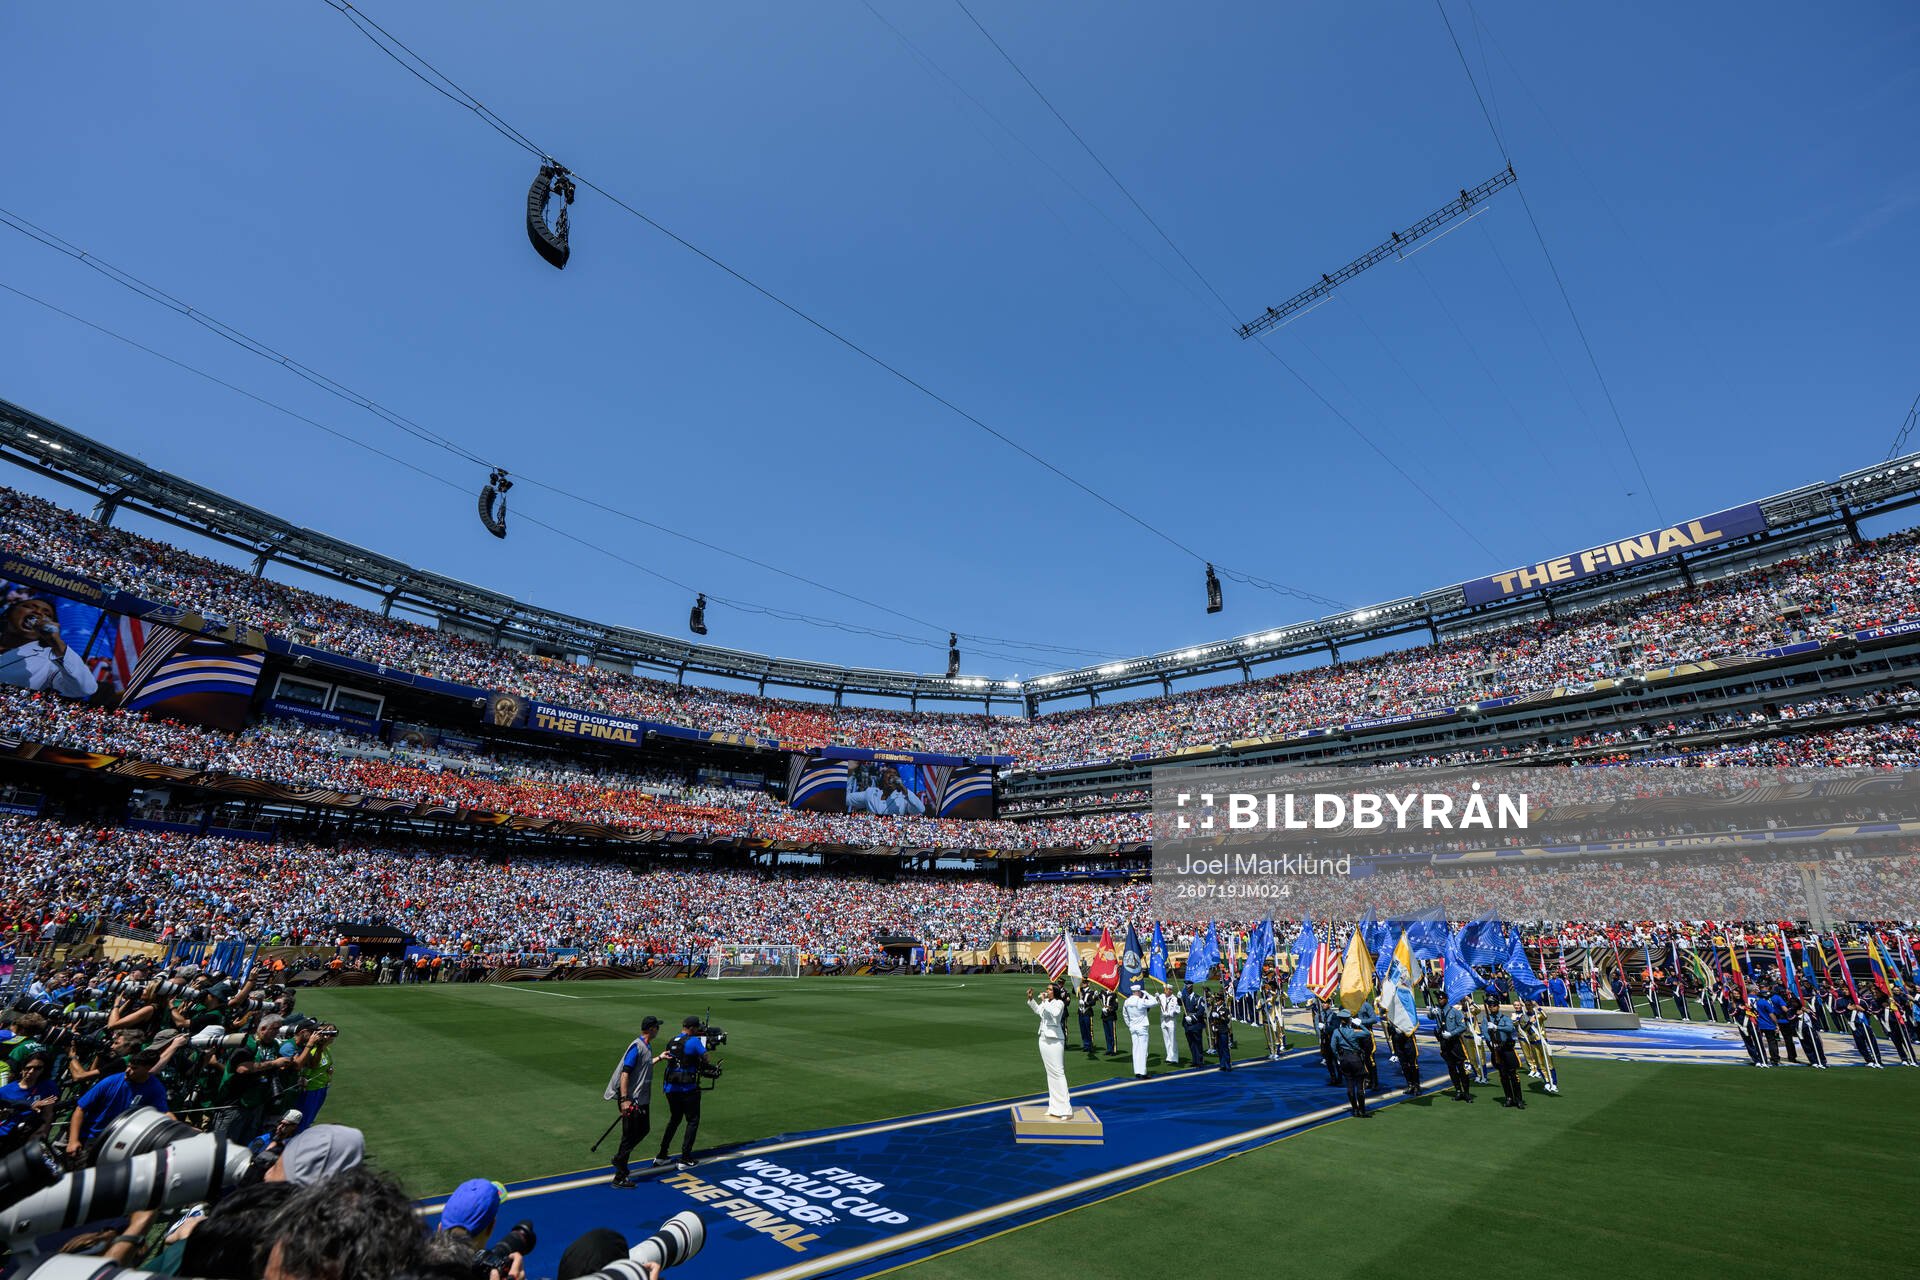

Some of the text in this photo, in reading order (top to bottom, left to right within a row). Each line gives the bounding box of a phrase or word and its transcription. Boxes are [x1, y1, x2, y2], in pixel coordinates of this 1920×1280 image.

[1491, 520, 1722, 594] THE FINAL
[3, 560, 103, 600] #FIFAWorldCup
[1868, 623, 1920, 638] FIA WORL
[288, 705, 309, 715] WORLD
[309, 710, 321, 718] CUP
[537, 706, 639, 731] FIFA WORLD CUP 2026
[1362, 720, 1381, 728] WORLD
[1427, 710, 1448, 718] FINAL
[536, 713, 637, 743] THE FINAL
[1606, 834, 1753, 850] THE FINAL
[736, 1158, 909, 1225] WORLD CUP
[811, 1166, 885, 1195] FIFA
[660, 1172, 821, 1252] THE FINAL
[720, 1176, 833, 1223] 2026
